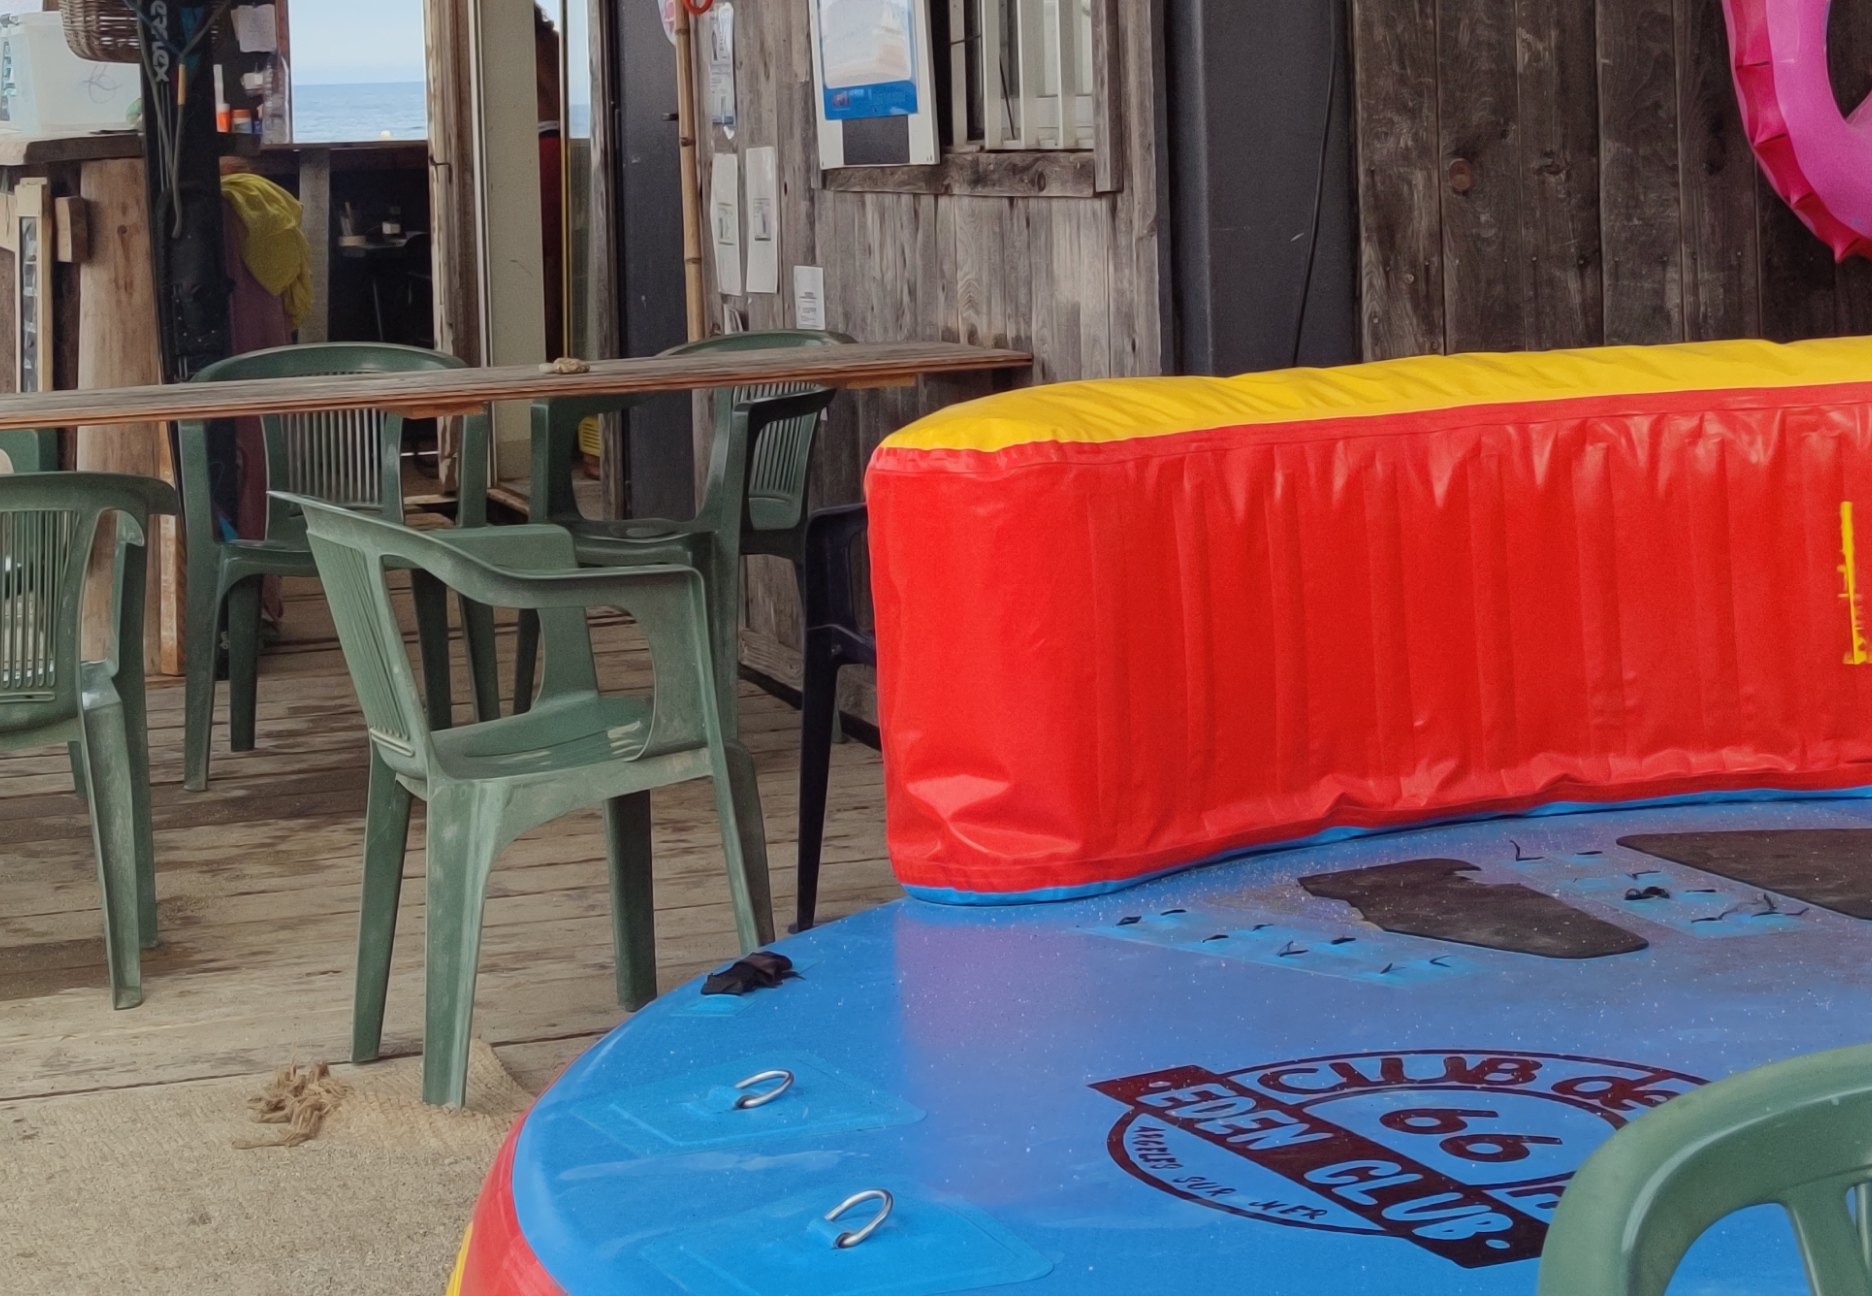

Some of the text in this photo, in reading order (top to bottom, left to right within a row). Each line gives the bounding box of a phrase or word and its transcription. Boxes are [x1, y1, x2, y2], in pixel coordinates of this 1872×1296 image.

[1257, 1056, 1543, 1095] CLUB
[1135, 1083, 1334, 1151] EDEN
[1379, 1108, 1564, 1163] 66
[1173, 1176, 1236, 1197] SUR
